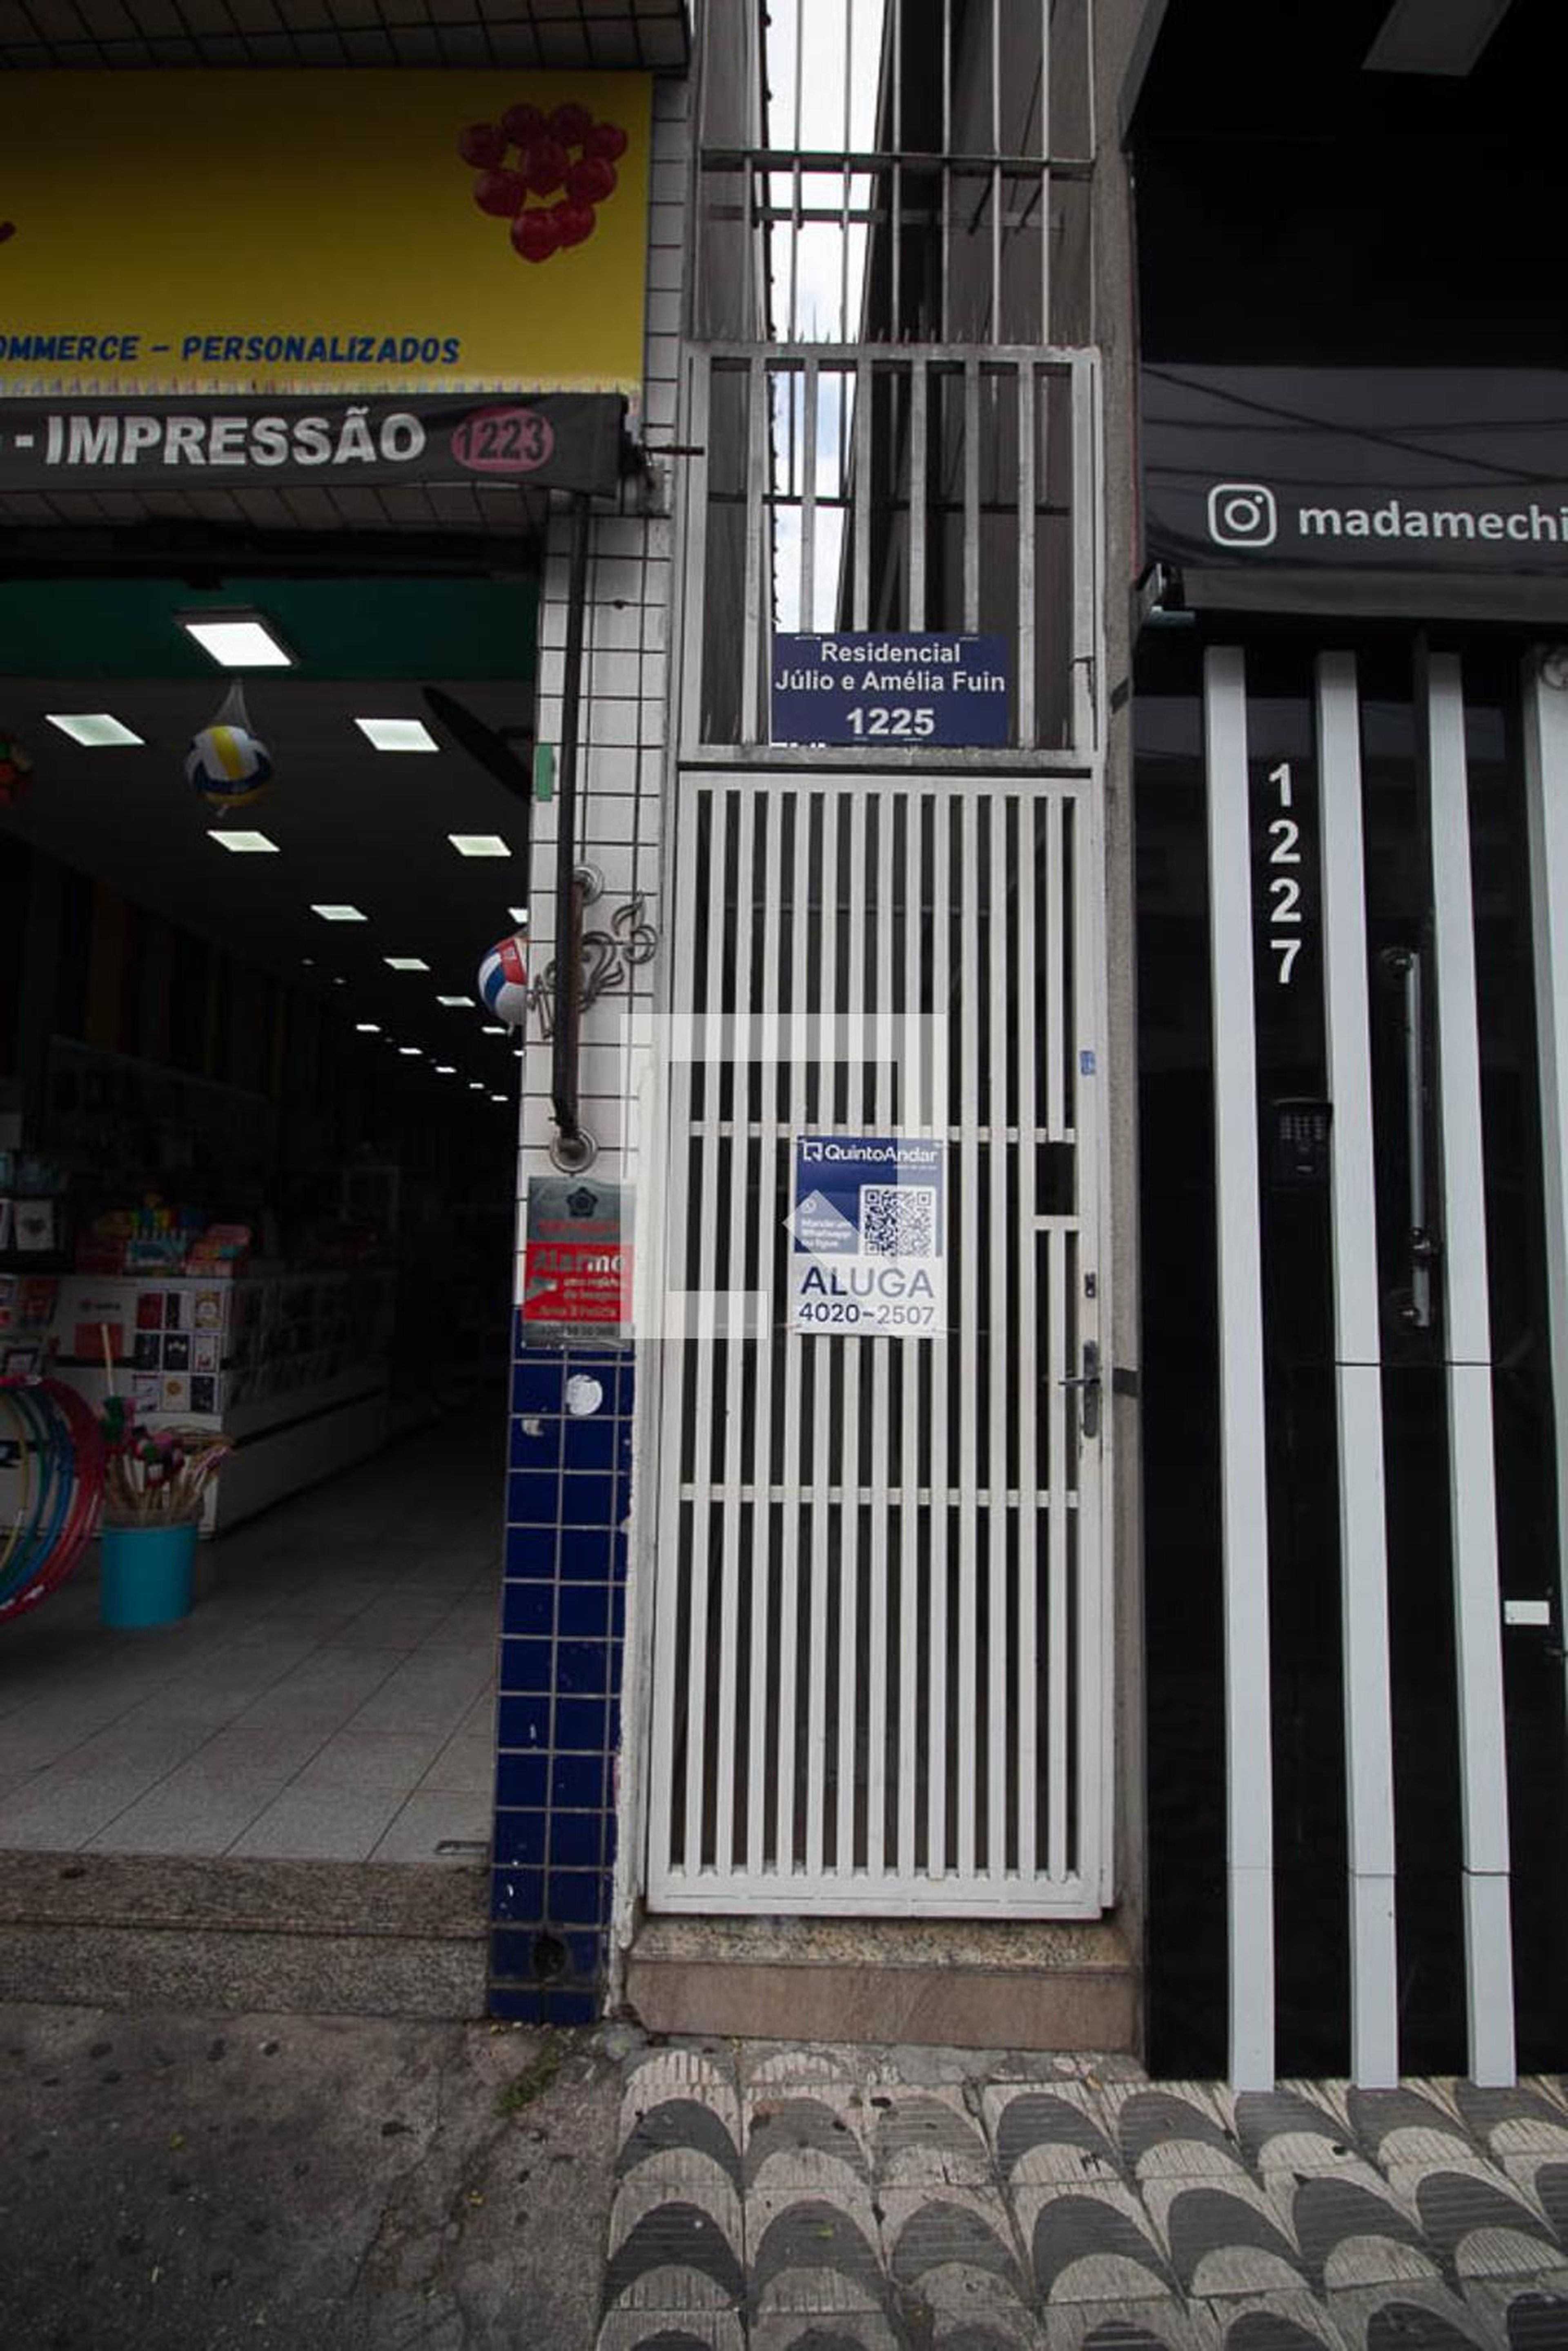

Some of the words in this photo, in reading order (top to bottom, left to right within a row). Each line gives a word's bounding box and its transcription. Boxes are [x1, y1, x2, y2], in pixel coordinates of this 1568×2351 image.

[182, 336, 460, 363] PERSONALIZADOS
[46, 407, 426, 465] IMPRESSÃO
[457, 415, 546, 461] 1223
[1298, 500, 1568, 542] madamechi
[821, 642, 960, 662] Residencial
[775, 669, 834, 690] Júlio
[841, 674, 855, 690] e
[862, 670, 944, 691] Amélia
[952, 671, 1005, 691] Fuin
[846, 708, 935, 735] 1225
[1269, 762, 1302, 984] 1227
[825, 1142, 938, 1162] QuintoAndar
[801, 1265, 934, 1299] ALUGA
[799, 1302, 935, 1325] 4020-2507
